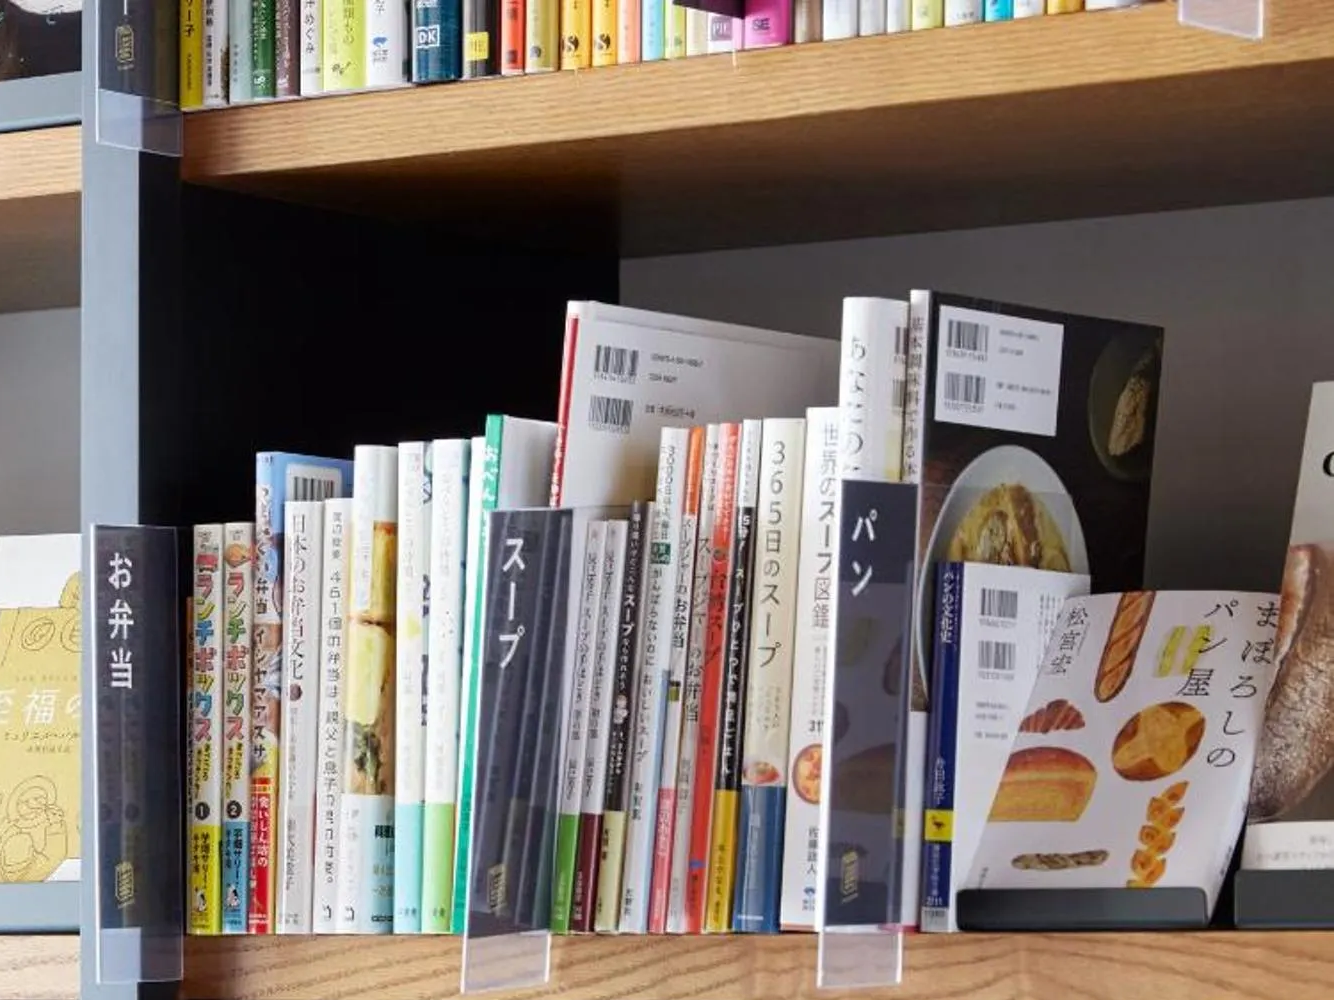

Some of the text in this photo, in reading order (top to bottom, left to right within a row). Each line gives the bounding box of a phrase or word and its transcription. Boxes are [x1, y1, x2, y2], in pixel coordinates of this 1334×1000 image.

[418, 29, 437, 45] DK
[291, 513, 309, 681] 日本のお弁当文化
[498, 537, 526, 669] スープ
[757, 440, 785, 669] 365日のスープ
[811, 422, 840, 629] 世界のスープ図鑑
[850, 508, 878, 596] パン
[107, 552, 135, 690] お弁当
[195, 574, 216, 742] ランチボックス
[223, 572, 248, 741] ランチボックス
[1176, 599, 1240, 697] パン屋
[1206, 602, 1278, 768] まぼろしの
